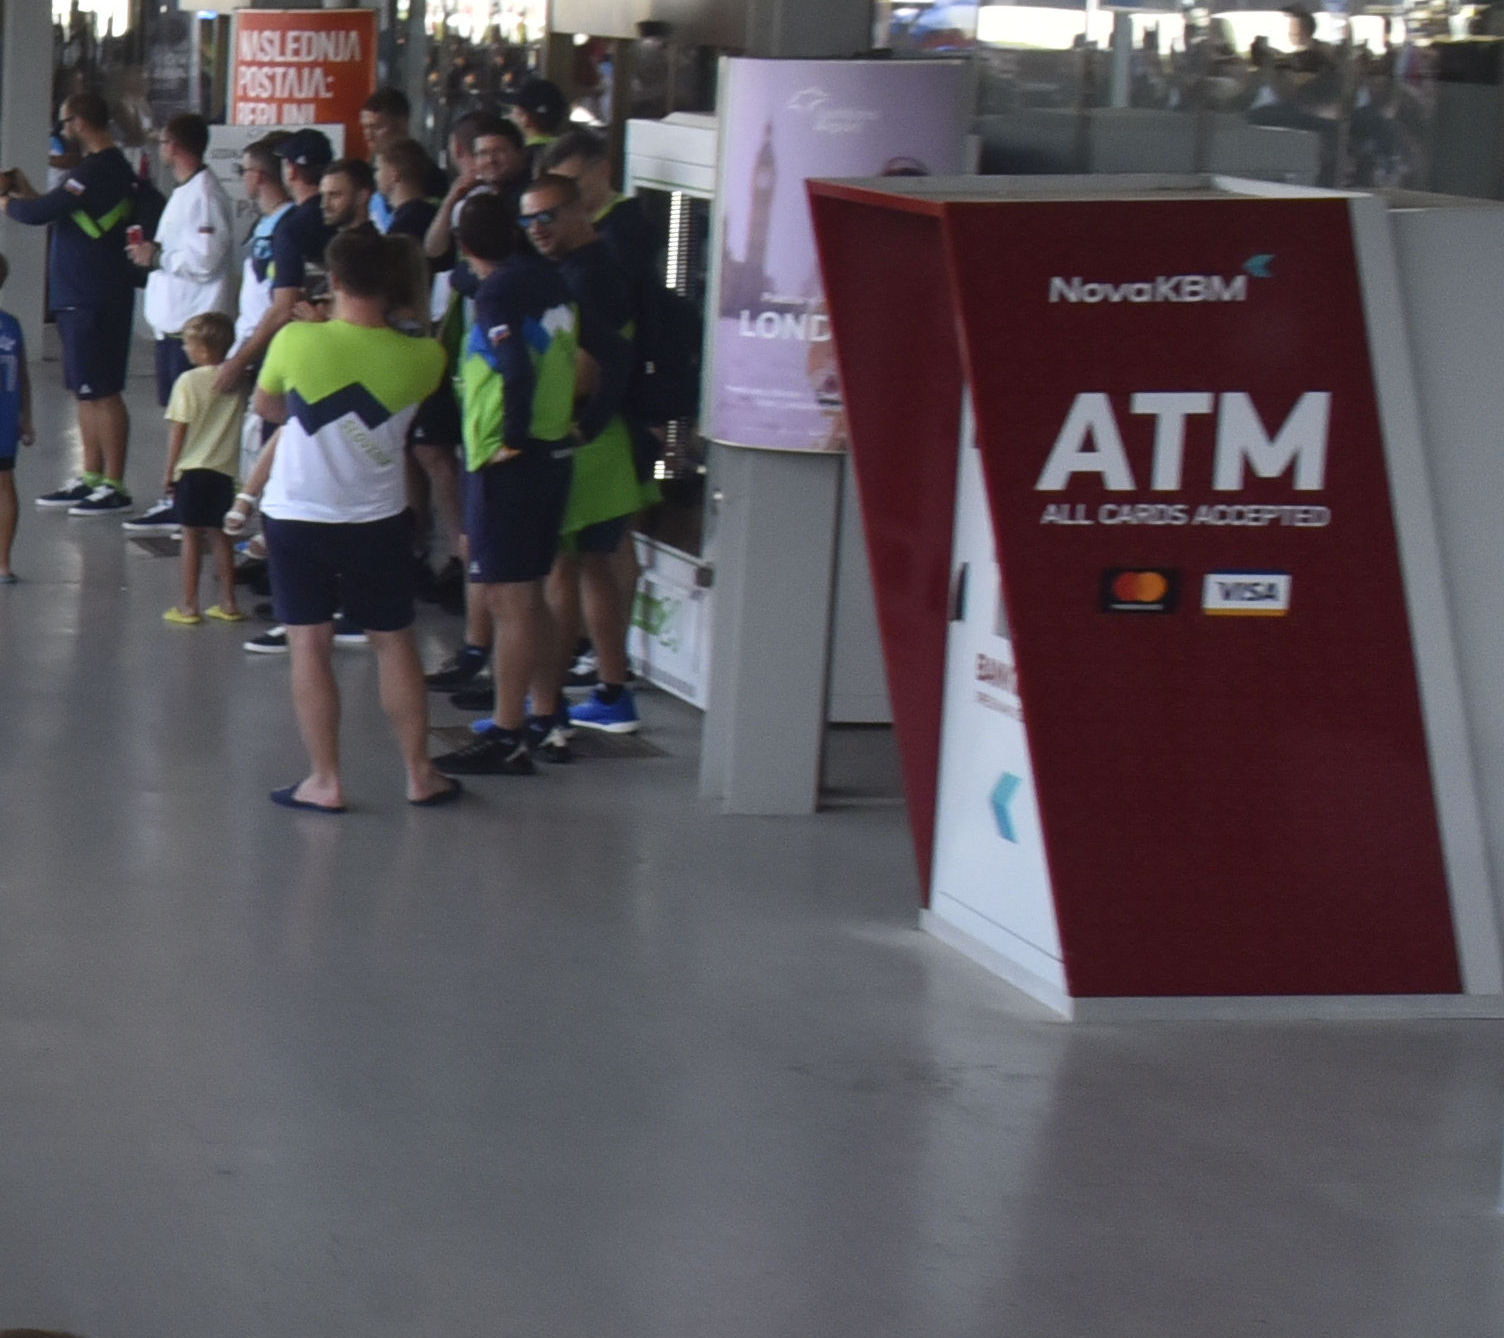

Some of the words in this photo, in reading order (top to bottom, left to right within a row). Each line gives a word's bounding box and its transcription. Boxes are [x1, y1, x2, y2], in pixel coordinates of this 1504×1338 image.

[739, 309, 833, 342] LOND
[1033, 391, 1333, 492] ATM
[1040, 504, 1095, 525] ALL
[1098, 504, 1190, 526] CARDS
[1190, 504, 1332, 527] ACCEPTED
[1216, 581, 1279, 602] VISA
